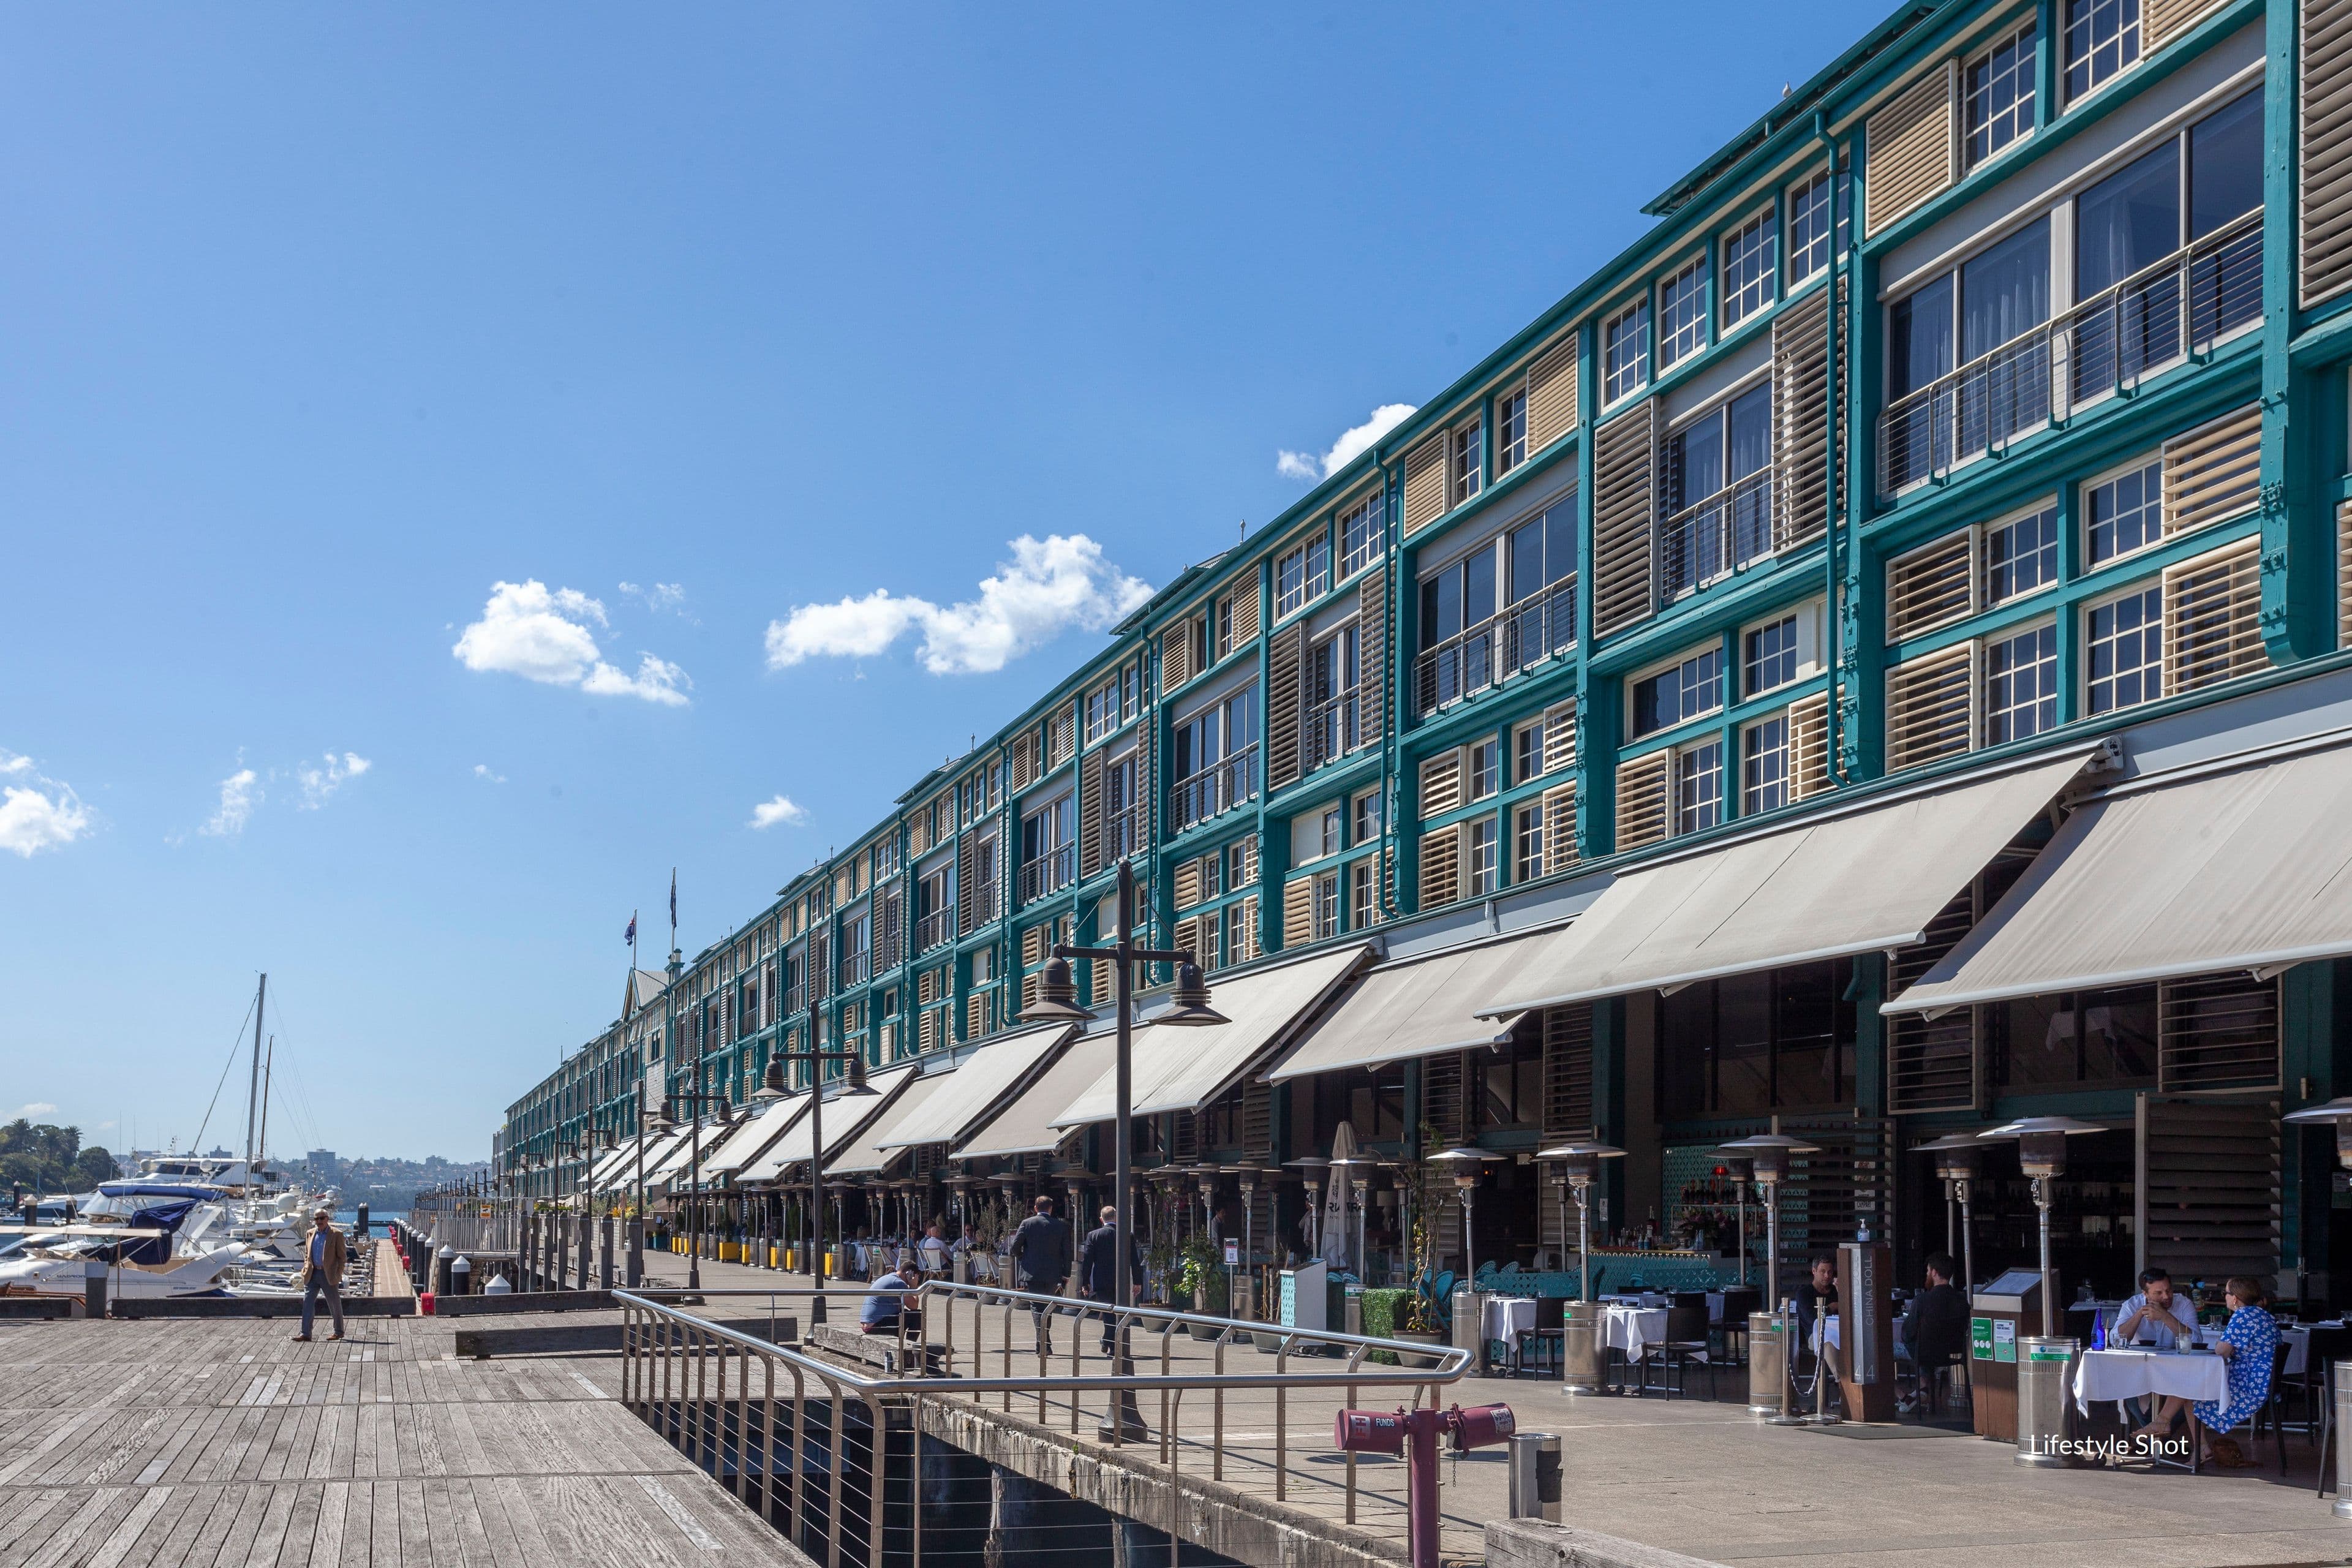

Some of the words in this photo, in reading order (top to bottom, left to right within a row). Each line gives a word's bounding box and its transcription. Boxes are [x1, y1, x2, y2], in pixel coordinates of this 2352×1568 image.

[1864, 1256, 1873, 1286] DOLL
[1866, 1289, 1874, 1325] CHINA
[1855, 1365, 1861, 1380] 4
[1866, 1365, 1875, 1380] 4
[1375, 1417, 1395, 1427] FUNDS
